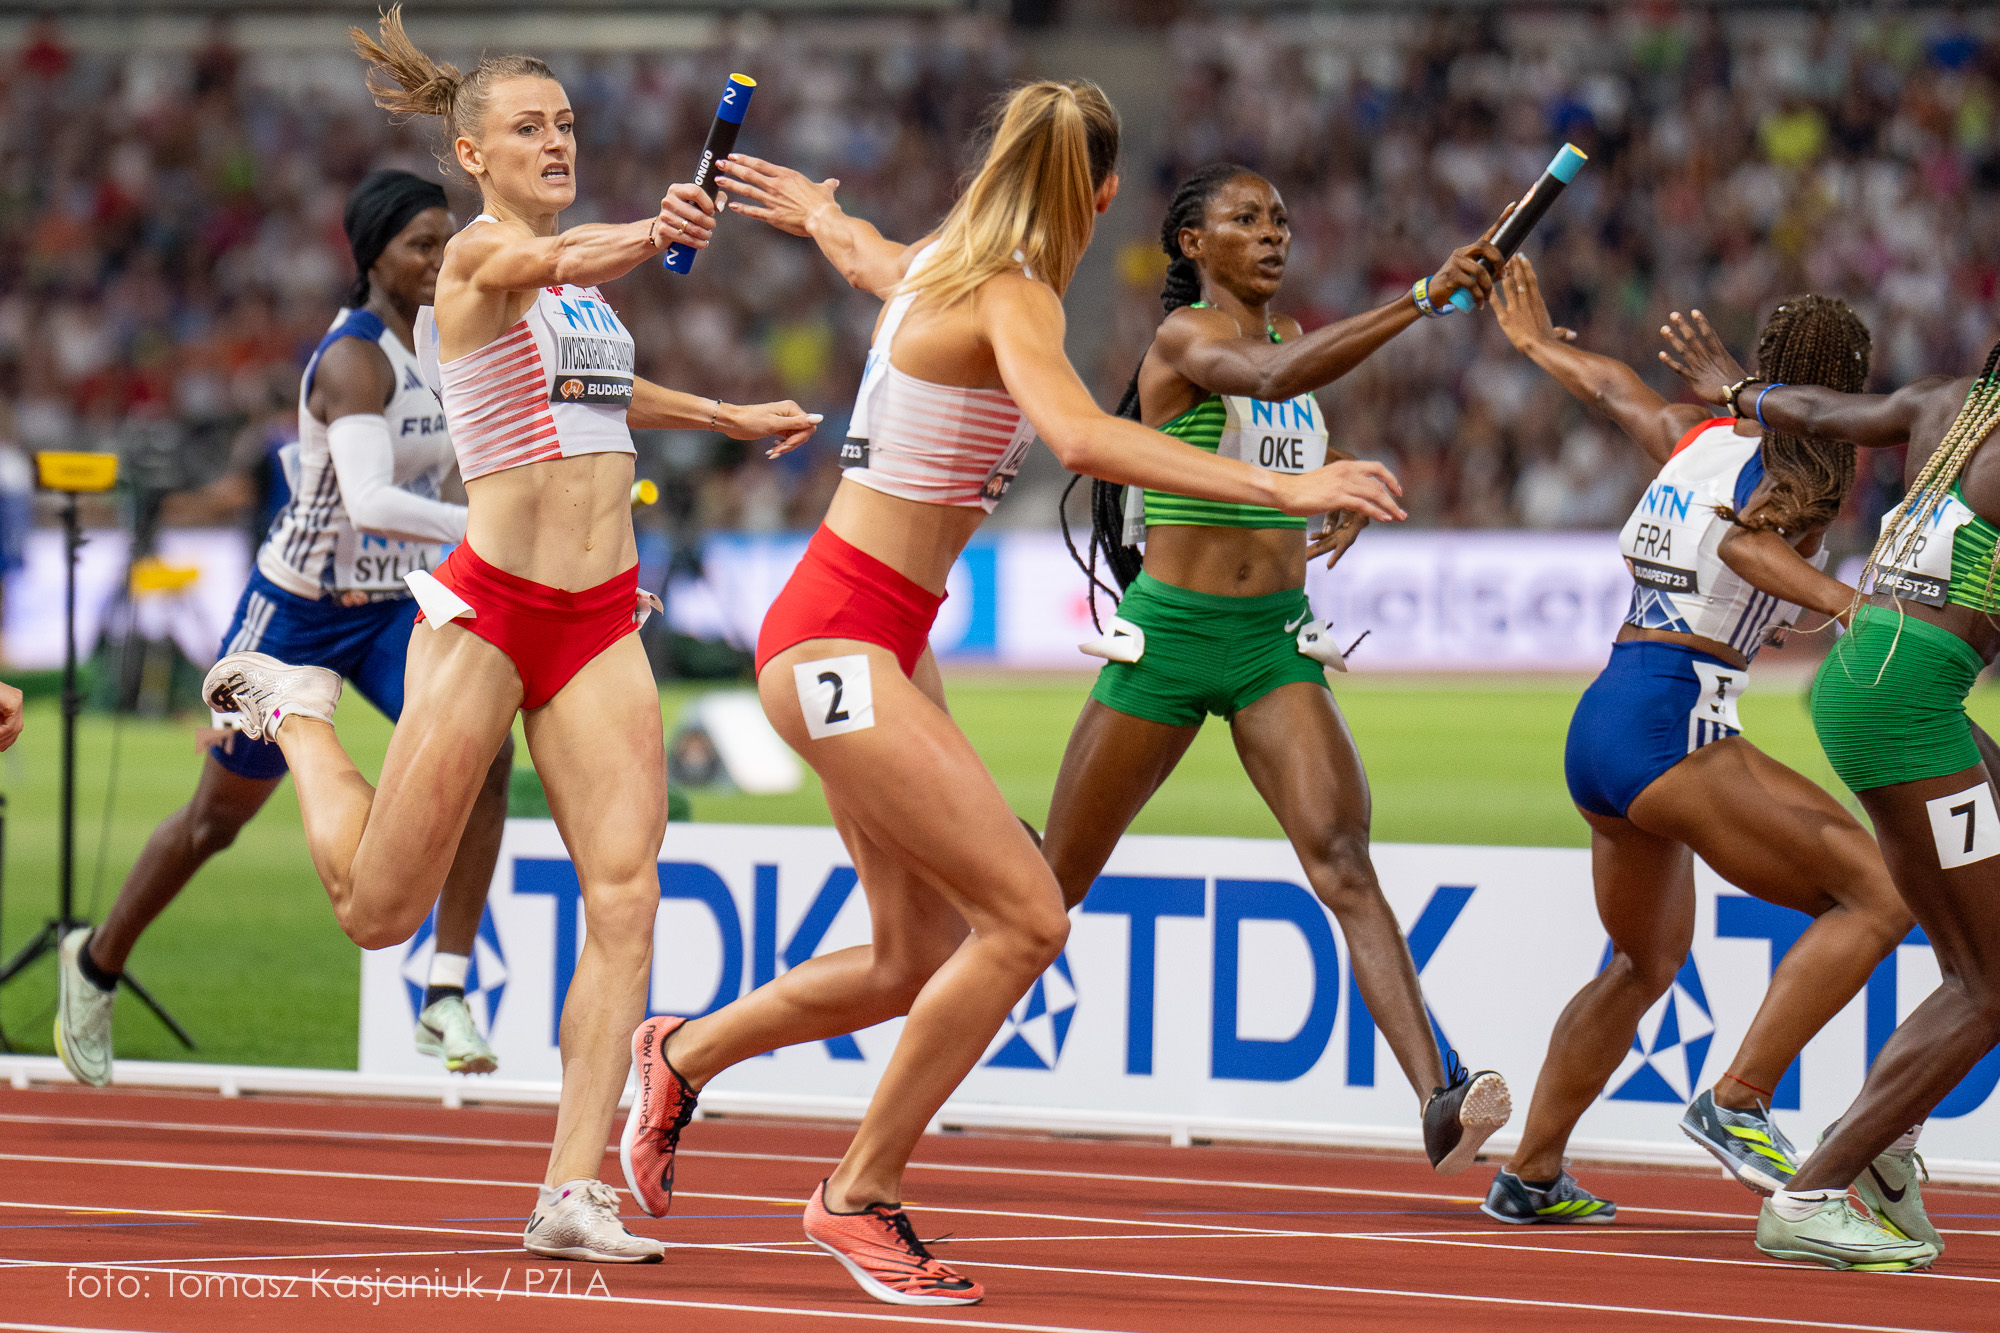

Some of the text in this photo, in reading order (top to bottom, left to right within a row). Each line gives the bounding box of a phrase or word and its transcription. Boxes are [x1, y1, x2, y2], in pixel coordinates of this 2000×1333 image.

[722, 87, 737, 105] 2
[560, 299, 620, 335] NTN
[1259, 435, 1305, 470] OKE
[1641, 483, 1695, 524] NTN
[1633, 522, 1672, 561] FRA
[816, 671, 850, 725] 2
[1950, 799, 1976, 854] 7
[1080, 875, 1478, 1088] TDK
[638, 1024, 657, 1137] new balance
